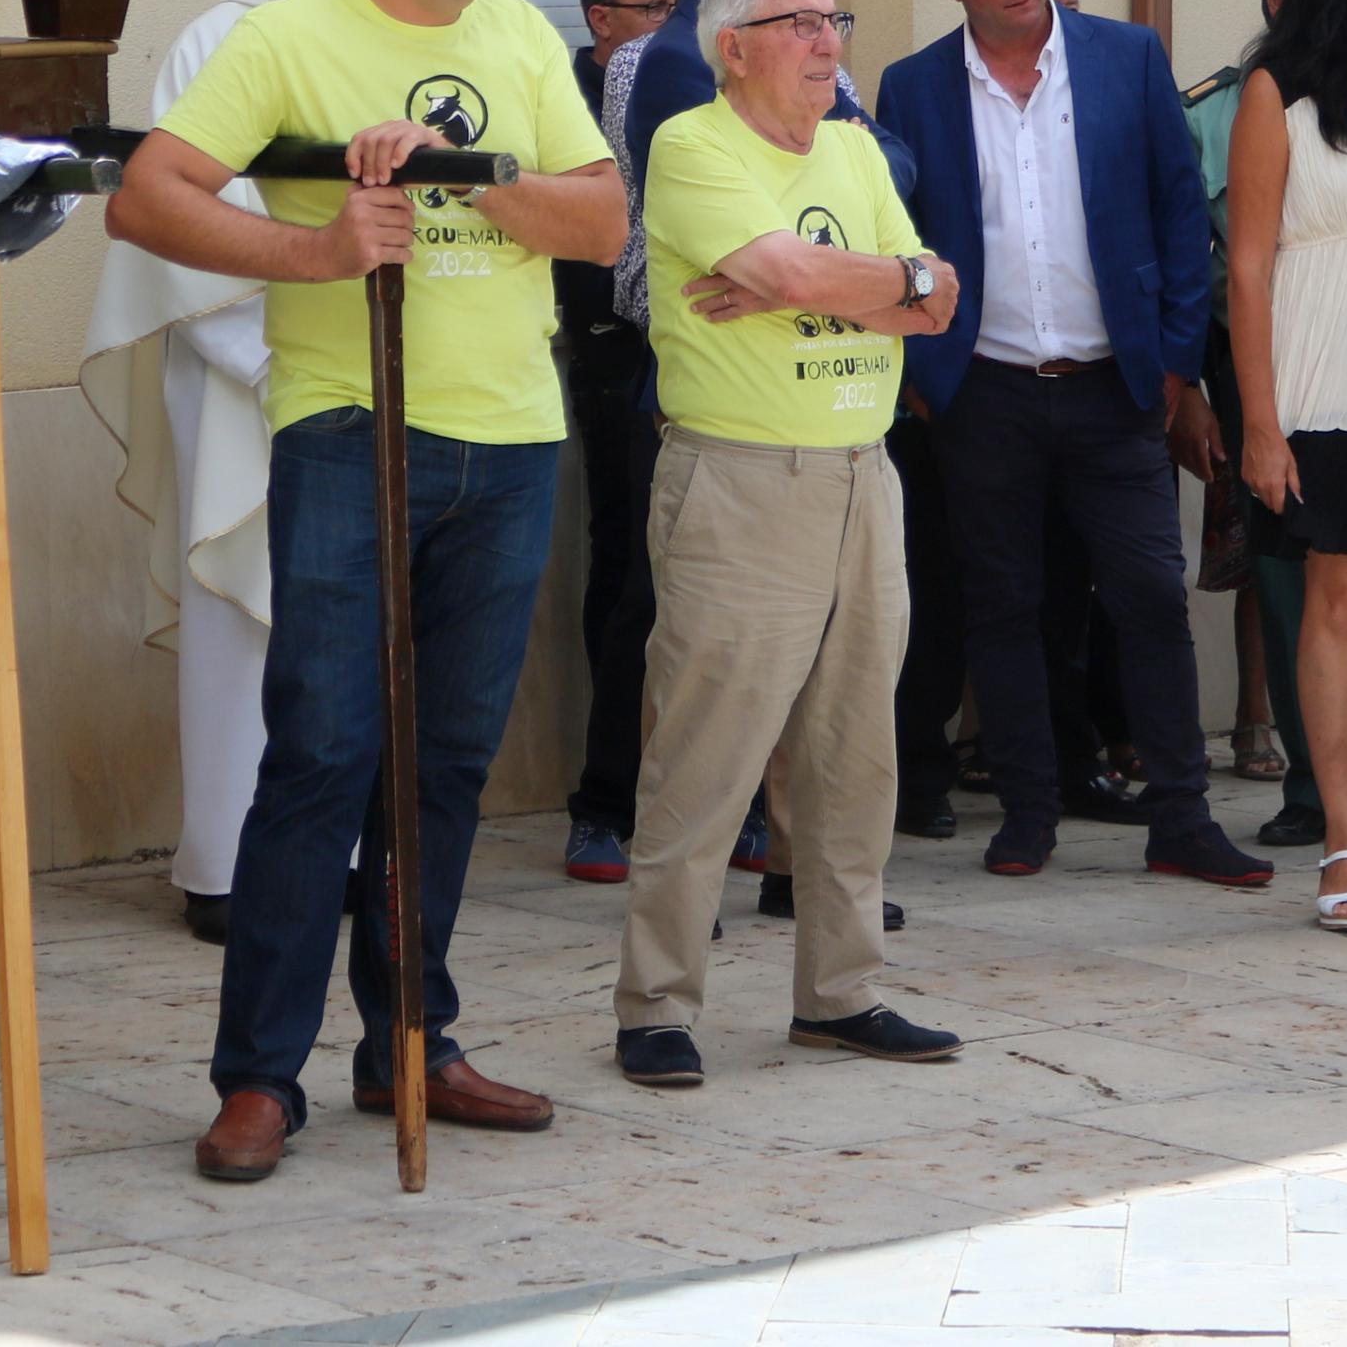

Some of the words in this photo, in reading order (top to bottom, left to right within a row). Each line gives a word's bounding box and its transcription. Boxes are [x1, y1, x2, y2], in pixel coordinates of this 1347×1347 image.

[426, 251, 492, 277] 2022
[794, 355, 891, 381] TORQUEMADA
[832, 382, 877, 412] 2022
